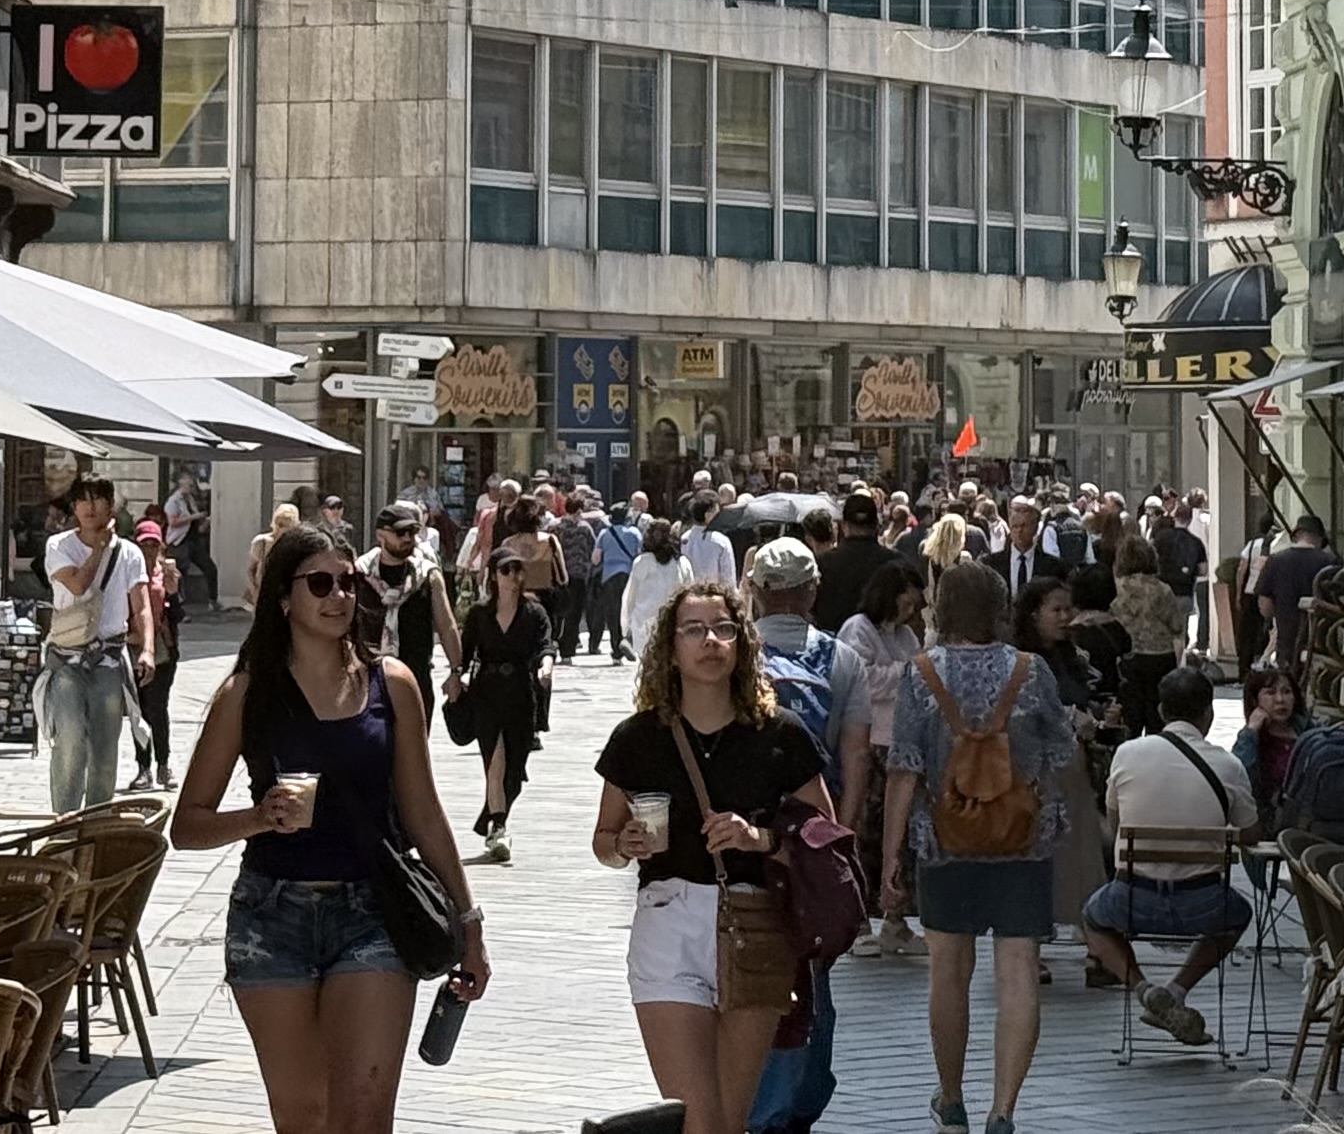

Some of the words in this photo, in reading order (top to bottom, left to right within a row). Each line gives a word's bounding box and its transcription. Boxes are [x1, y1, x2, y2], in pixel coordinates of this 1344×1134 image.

[38, 23, 54, 92] I
[14, 102, 154, 151] Pizza
[681, 347, 714, 362] ATM
[611, 444, 629, 456] ATM
